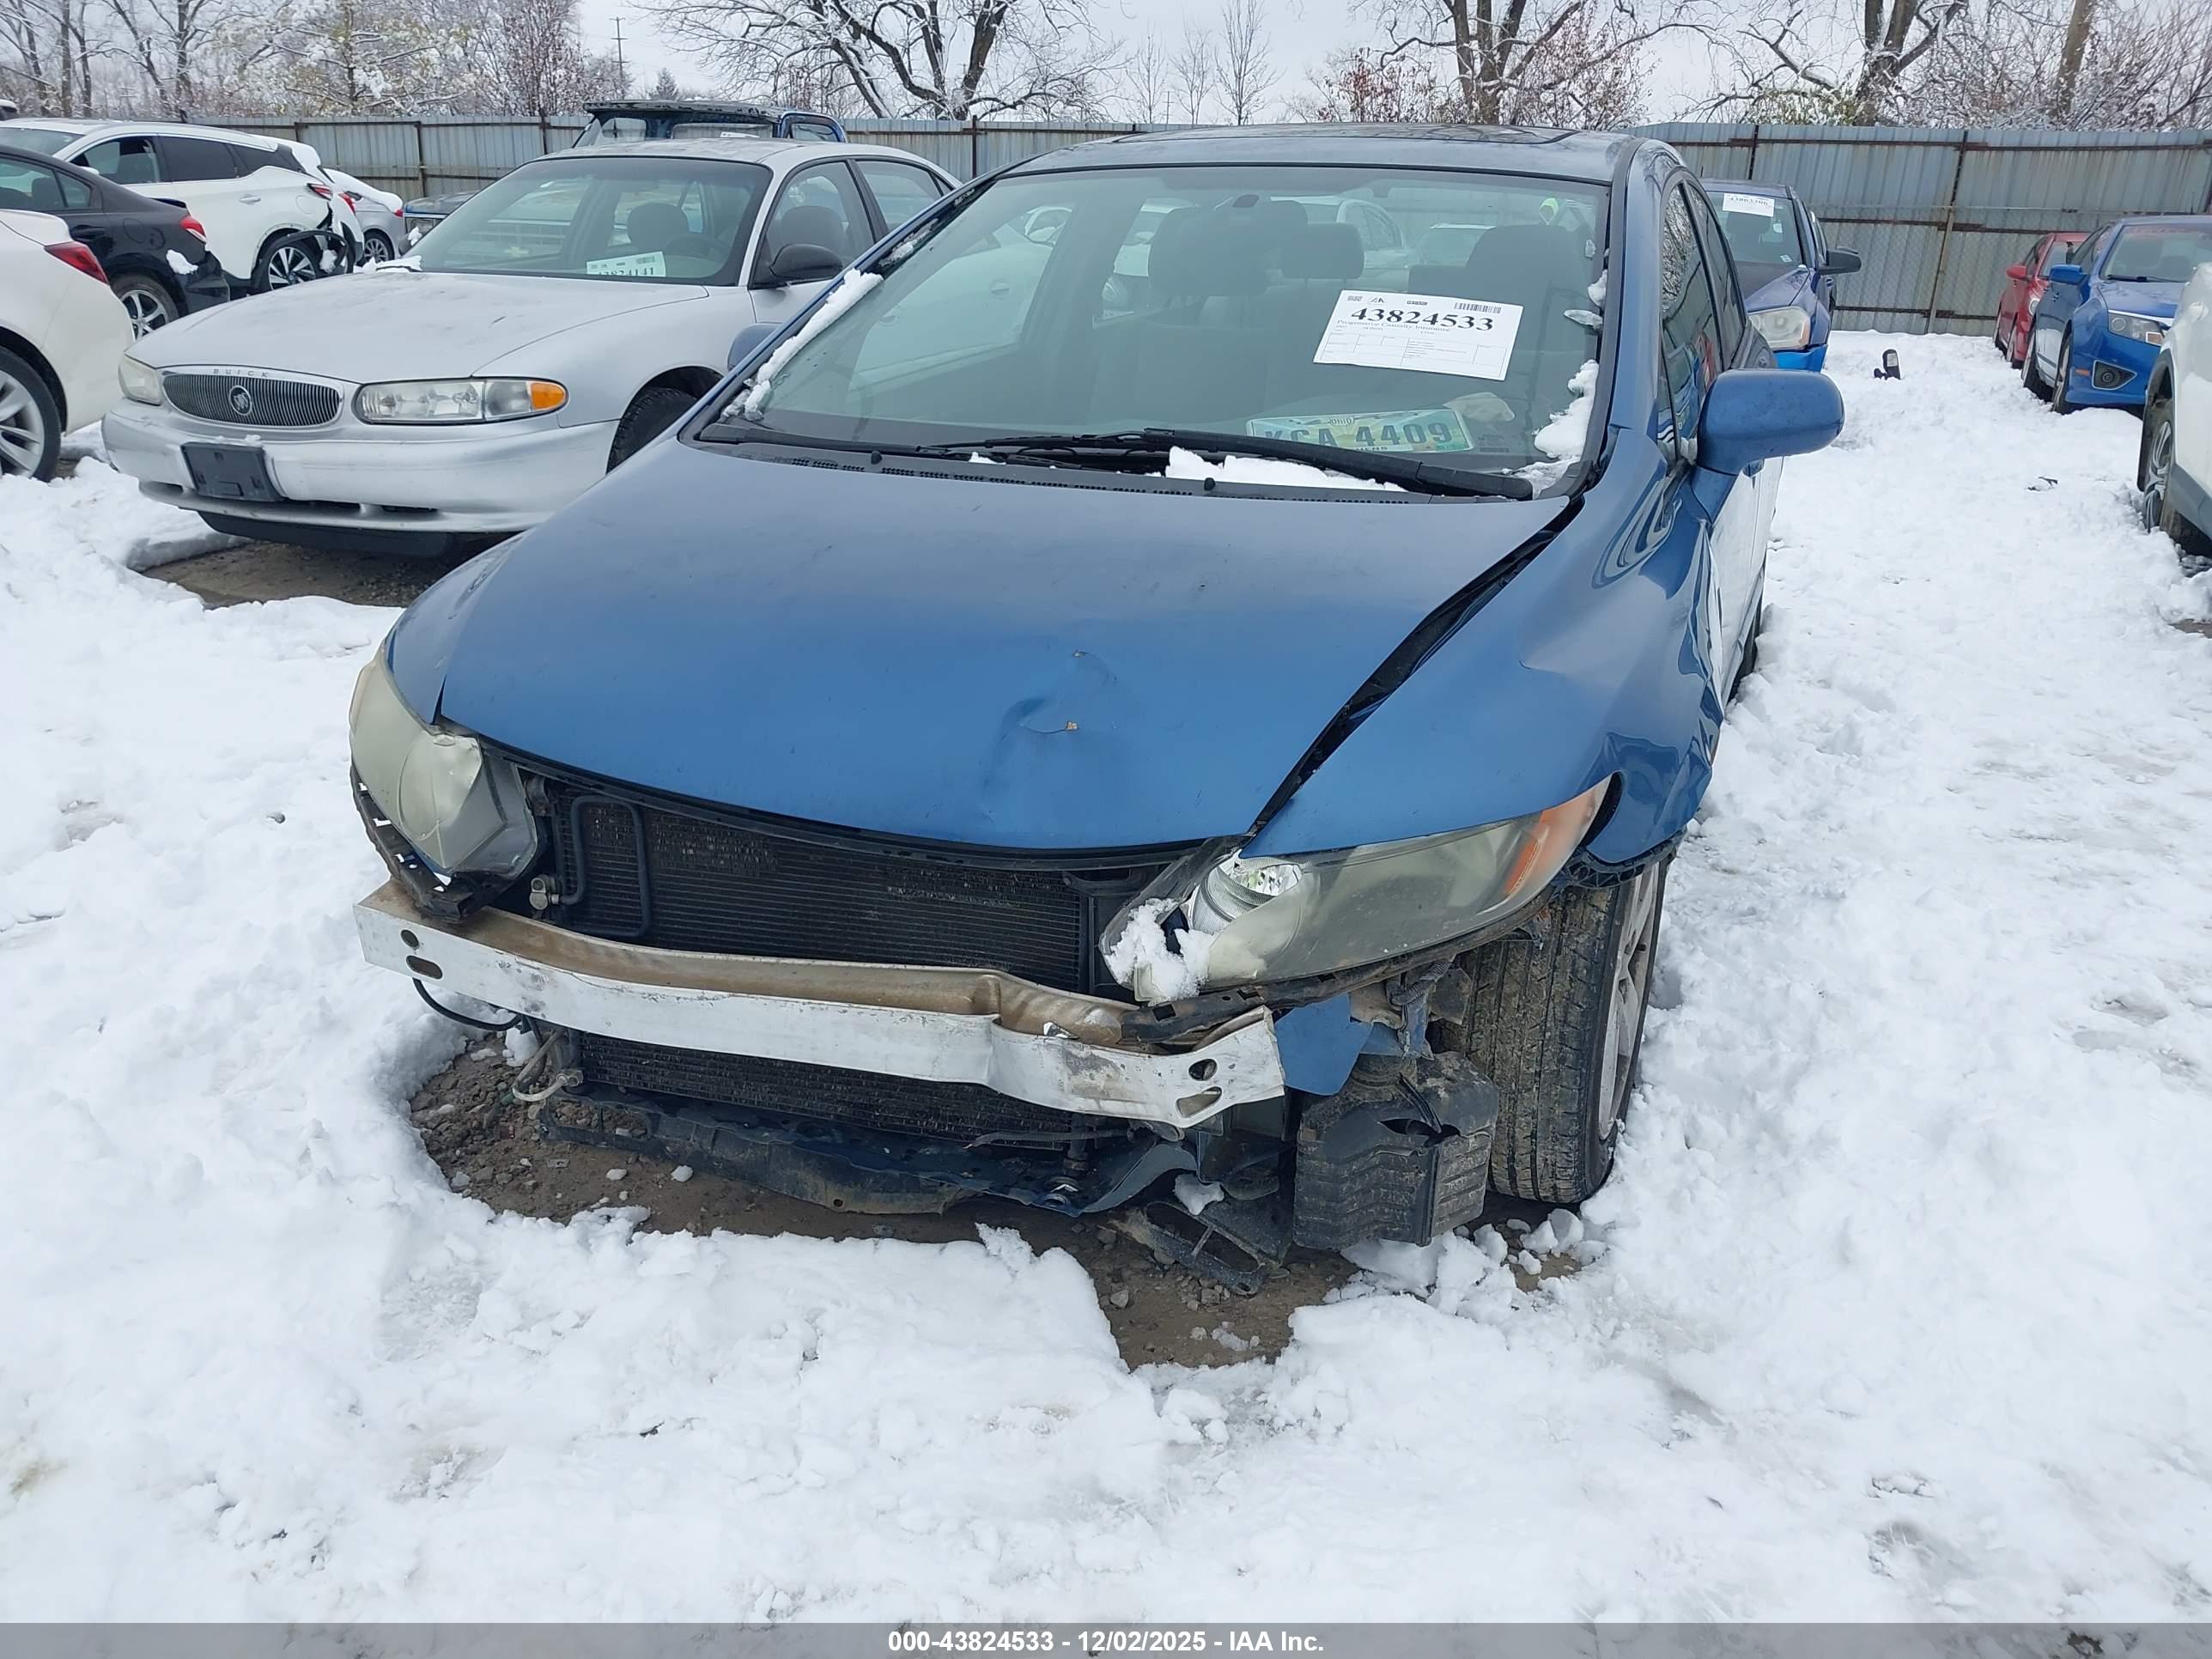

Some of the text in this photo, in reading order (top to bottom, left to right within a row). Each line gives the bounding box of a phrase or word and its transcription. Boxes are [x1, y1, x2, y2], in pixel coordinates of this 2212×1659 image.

[1351, 307, 1494, 331] 43824533
[213, 368, 269, 378] BUICK
[1355, 422, 1453, 447] 4409
